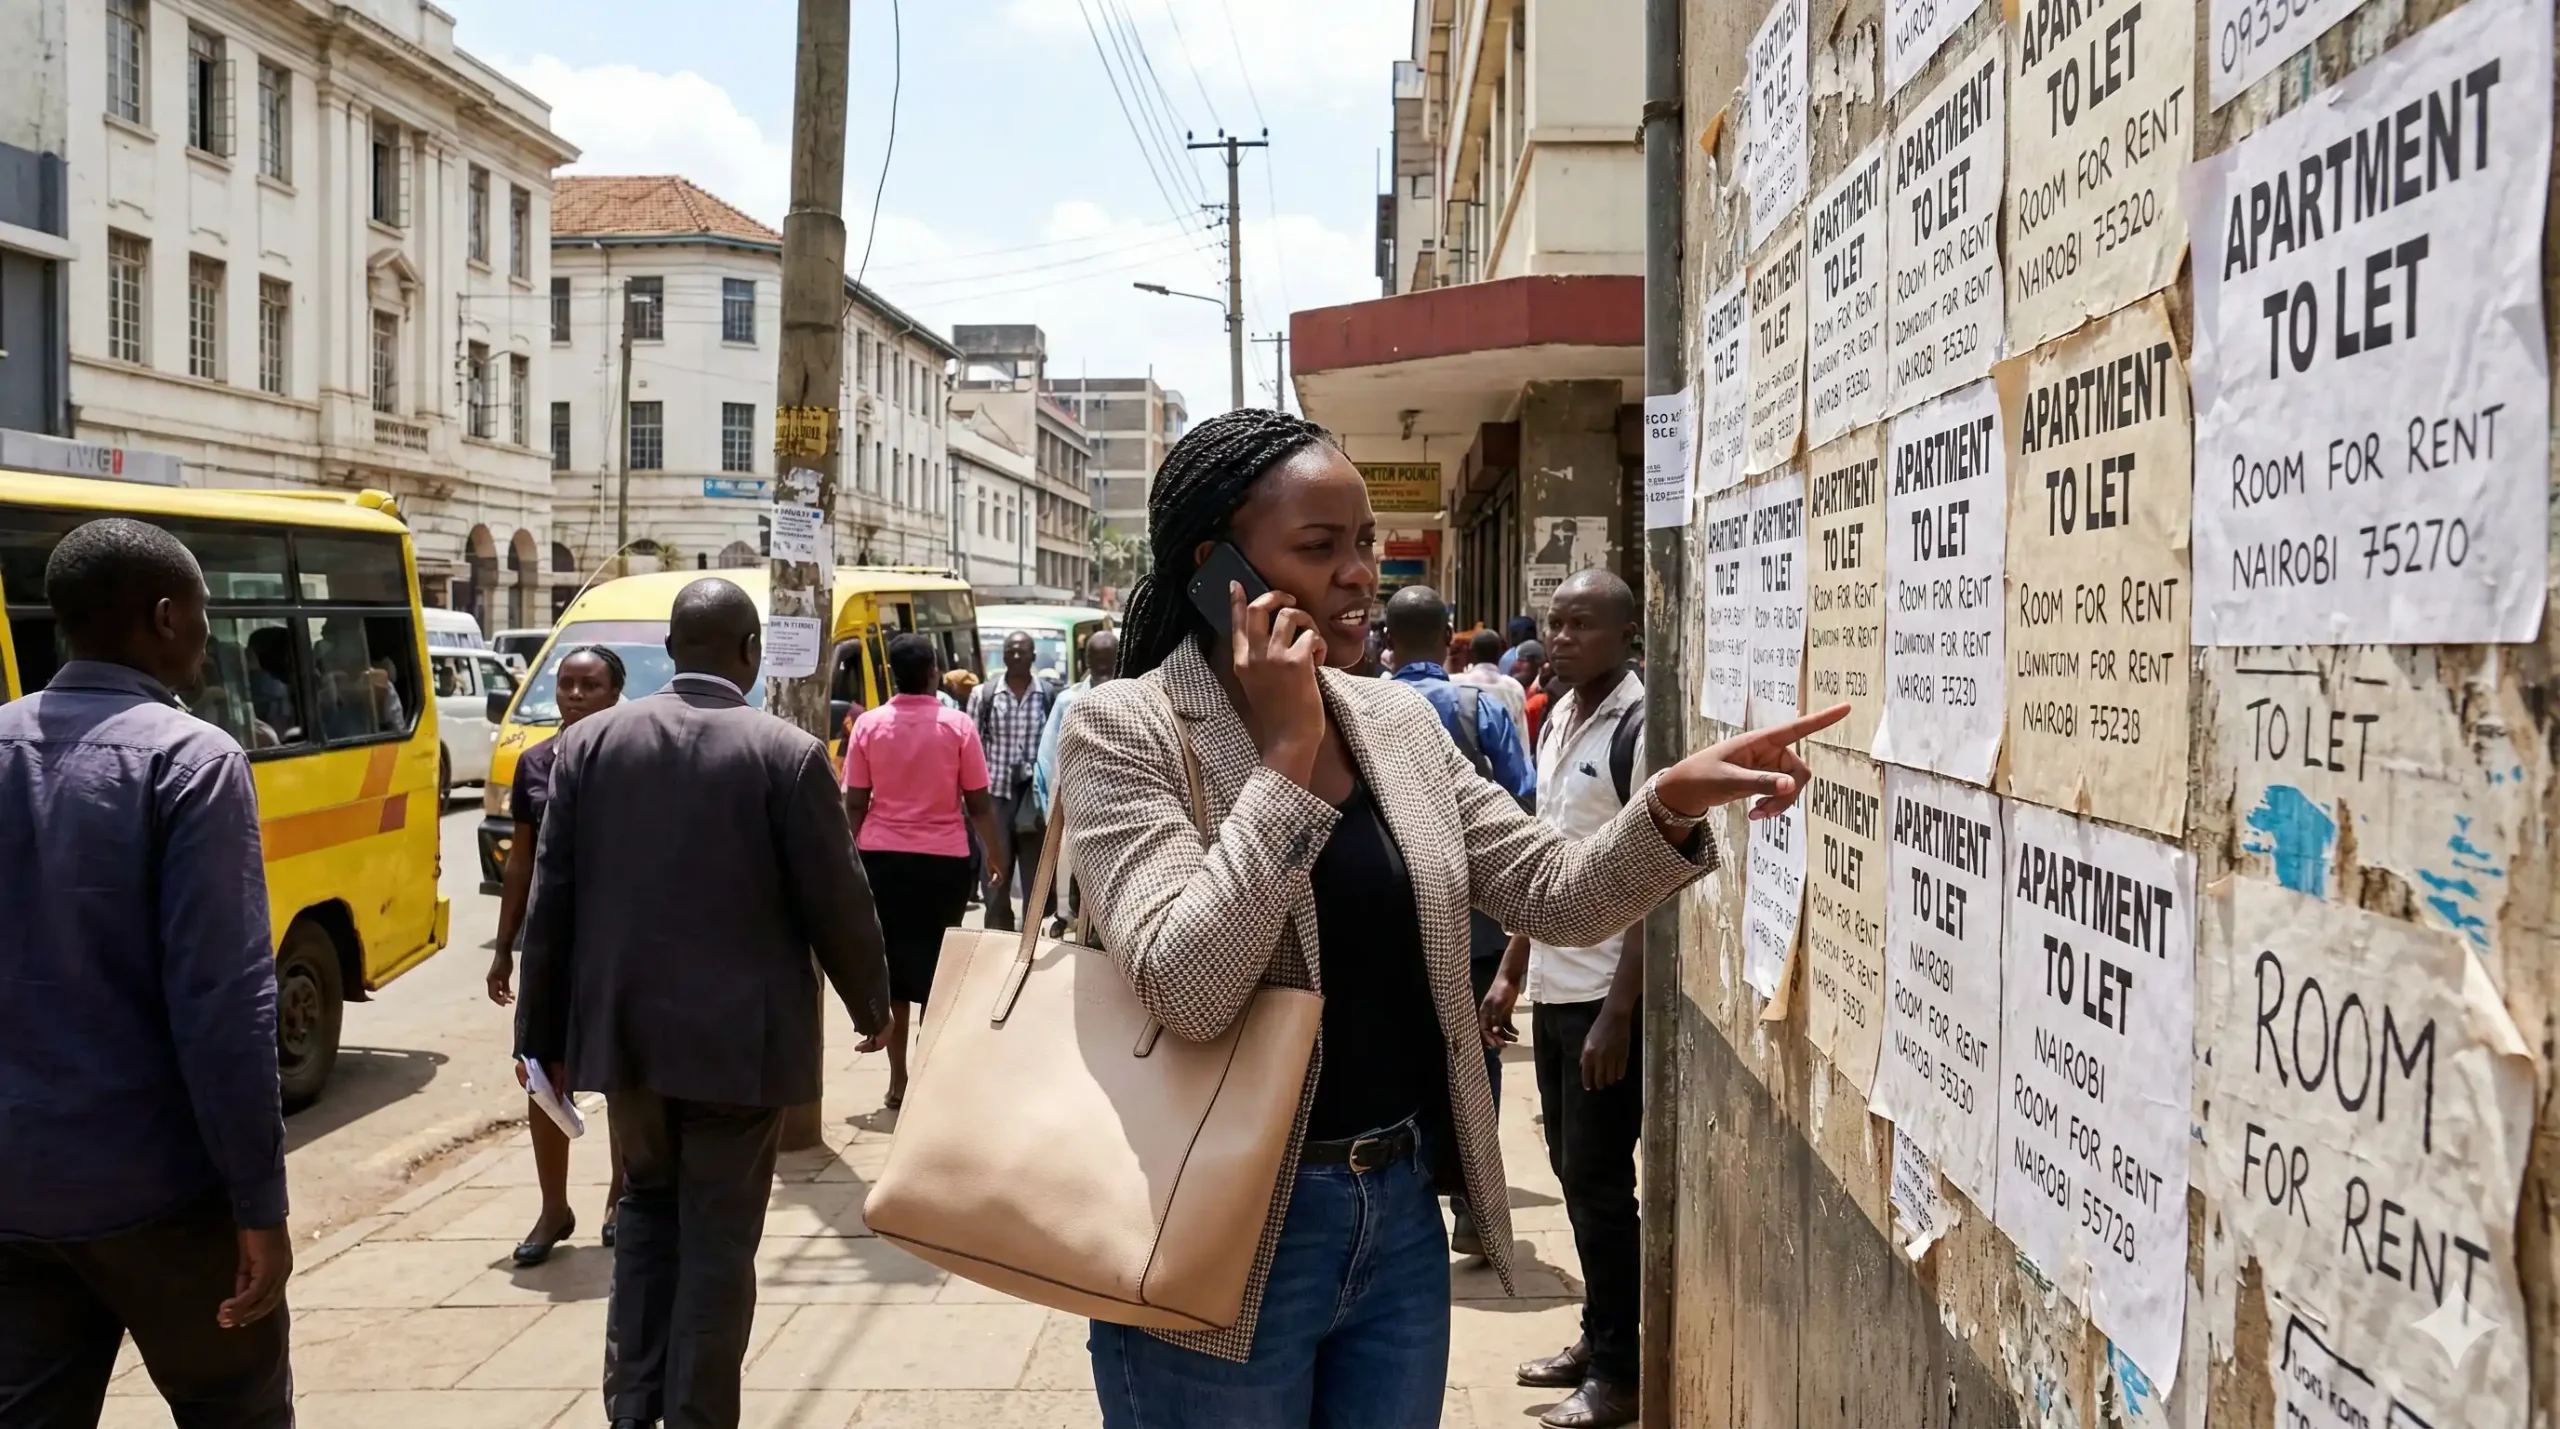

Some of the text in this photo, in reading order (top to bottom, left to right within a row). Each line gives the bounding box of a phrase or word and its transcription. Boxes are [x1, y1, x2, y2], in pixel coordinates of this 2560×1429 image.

[1755, 0, 1801, 87] APARTMENT
[2047, 1, 2142, 138] TO LET
[1763, 51, 1793, 124] TO LET
[1897, 57, 1995, 195] APARTMENT
[2019, 85, 2185, 241] ROOM FOR RENT
[2224, 57, 2500, 282] APARTMENT
[1812, 157, 1881, 258] APARTMENT
[1912, 156, 1971, 247] TO LET
[1752, 241, 1803, 318] APARTMENT
[1824, 232, 1865, 302] TO LET
[1897, 212, 1993, 306] ROOM FOR RENT
[1943, 291, 1958, 318] FOR
[1965, 265, 1993, 305] RENT
[2018, 231, 2082, 303] NAIROBI
[1708, 287, 1747, 350] APARTMENT
[1760, 302, 1791, 358] TO LET
[1837, 300, 1851, 335] FOR
[1855, 282, 1878, 320] RENT
[2263, 233, 2429, 380] TO LET
[1714, 338, 1739, 386] TO LET
[1897, 322, 1978, 389] NAIROBI 75320
[2022, 341, 2173, 455] APARTMENT
[1811, 458, 1878, 518] APARTMENT
[1894, 414, 1994, 497] APARTMENT
[2233, 403, 2506, 509] ROOM FOR RENT
[1752, 497, 1803, 545] APARTMENT
[2046, 452, 2135, 536] TO LET
[1708, 513, 1748, 554] APARTMENT
[1823, 522, 1864, 571] TO LET
[1911, 499, 1970, 562] TO LET
[2233, 518, 2469, 591] NAIROBI 75270
[1715, 561, 1739, 597] TO LET
[1761, 552, 1792, 592] TO LET
[1838, 585, 1850, 609] FOR
[1855, 583, 1878, 610] RENT
[1899, 574, 1992, 613] ROOM FOR RENT
[2020, 576, 2178, 628] ROOM FOR RENT
[1843, 627, 1855, 648] FOR
[1941, 631, 1958, 657] FOR
[1963, 631, 1991, 658] RENT
[2091, 650, 2117, 681] FOR
[2129, 649, 2174, 685] RENT
[1896, 673, 1977, 707] NAIROBI 75230
[2023, 701, 2141, 744] NAIROBI 75238
[2246, 698, 2380, 782] TO LET
[1774, 813, 1791, 854] LET
[1812, 776, 1879, 841] APARTMENT
[1894, 795, 1991, 880] APARTMENT
[1823, 834, 1863, 893] TO LET
[1813, 883, 1833, 921] ROOM
[1837, 903, 1851, 934] FOR
[1855, 910, 1879, 952] RENT
[1911, 866, 1967, 941] TO LET
[2017, 842, 2173, 960] APARTMENT
[1843, 949, 1879, 996] FOR RENT
[1910, 940, 1953, 995] NAIROBI
[2042, 933, 2133, 1036] TO LET
[1895, 978, 1988, 1073] ROOM FOR RENT
[2254, 950, 2436, 1154] ROOM
[1895, 1029, 1974, 1116] NAIROBI 35330
[2035, 1025, 2105, 1104] NAIROBI
[2014, 1073, 2163, 1214] ROOM FOR RENT
[2014, 1136, 2071, 1212] NAIROBI
[2243, 1122, 2489, 1326] FOR RENT
